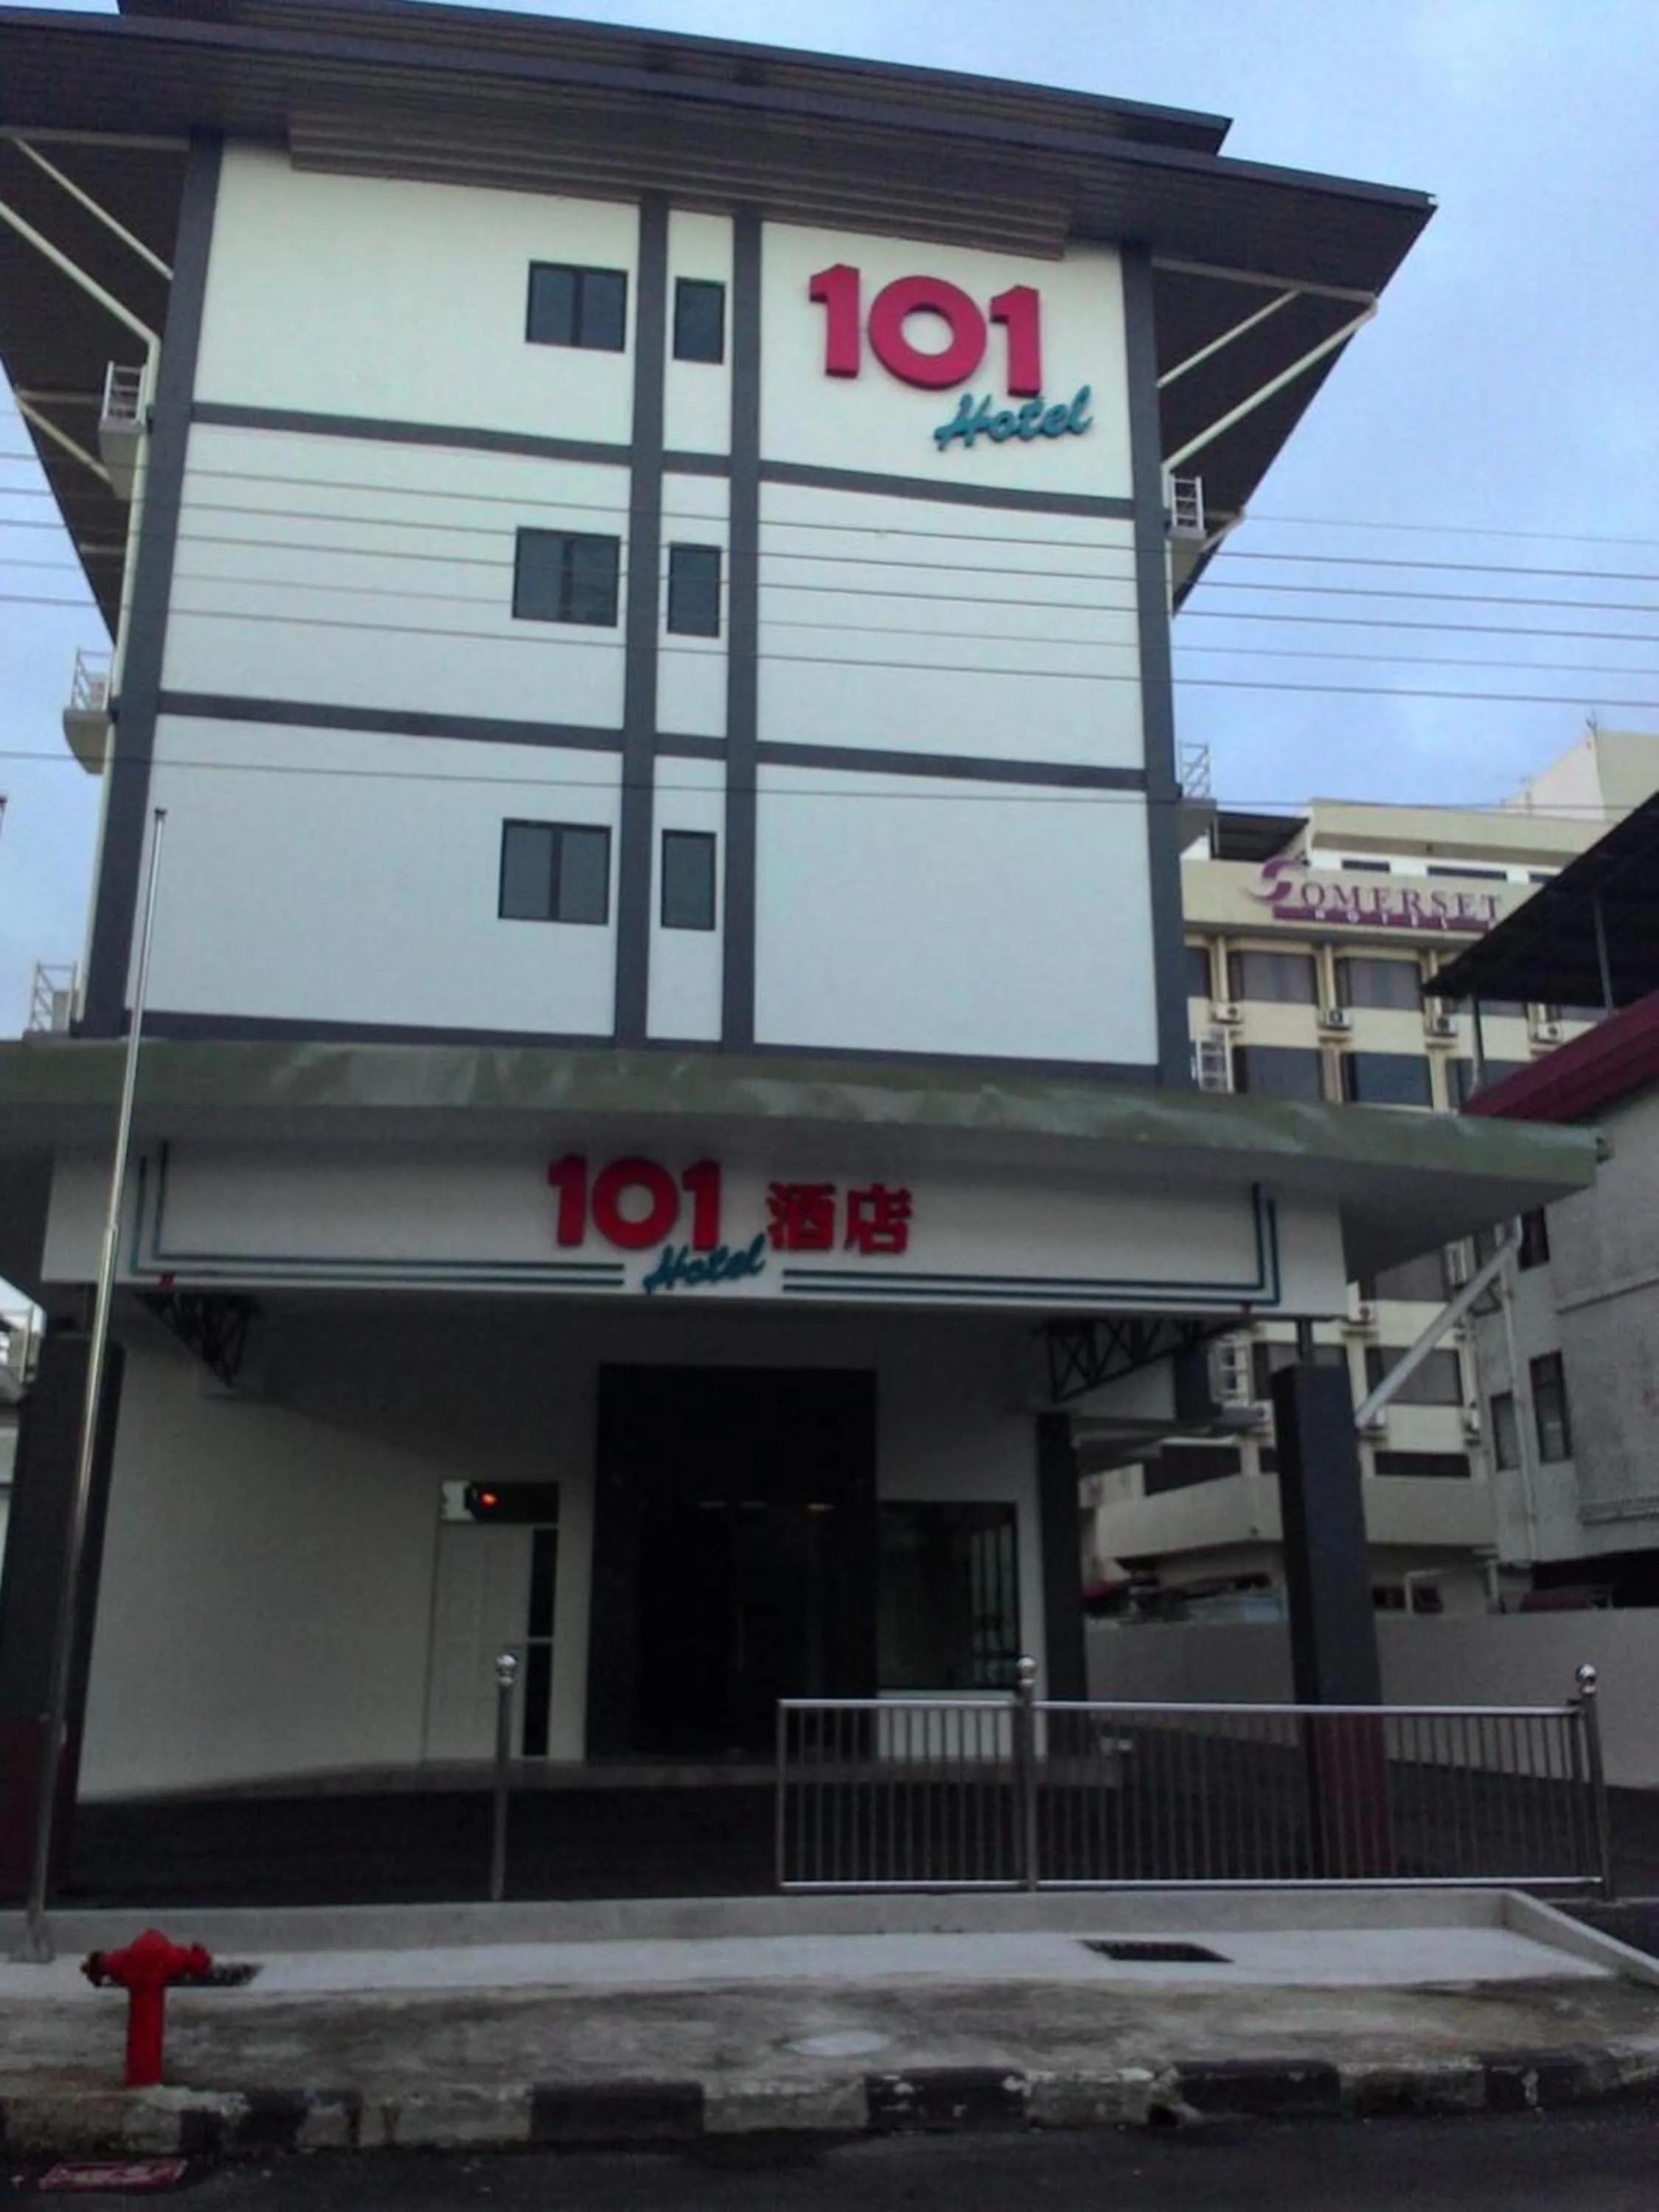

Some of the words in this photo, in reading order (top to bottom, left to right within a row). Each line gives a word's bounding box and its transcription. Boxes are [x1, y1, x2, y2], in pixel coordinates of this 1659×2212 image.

[809, 263, 1041, 397] 101
[933, 384, 1094, 452] Hotel
[548, 1153, 722, 1252] 101
[767, 1182, 913, 1256] 酒店
[642, 1232, 766, 1295] Hotel
